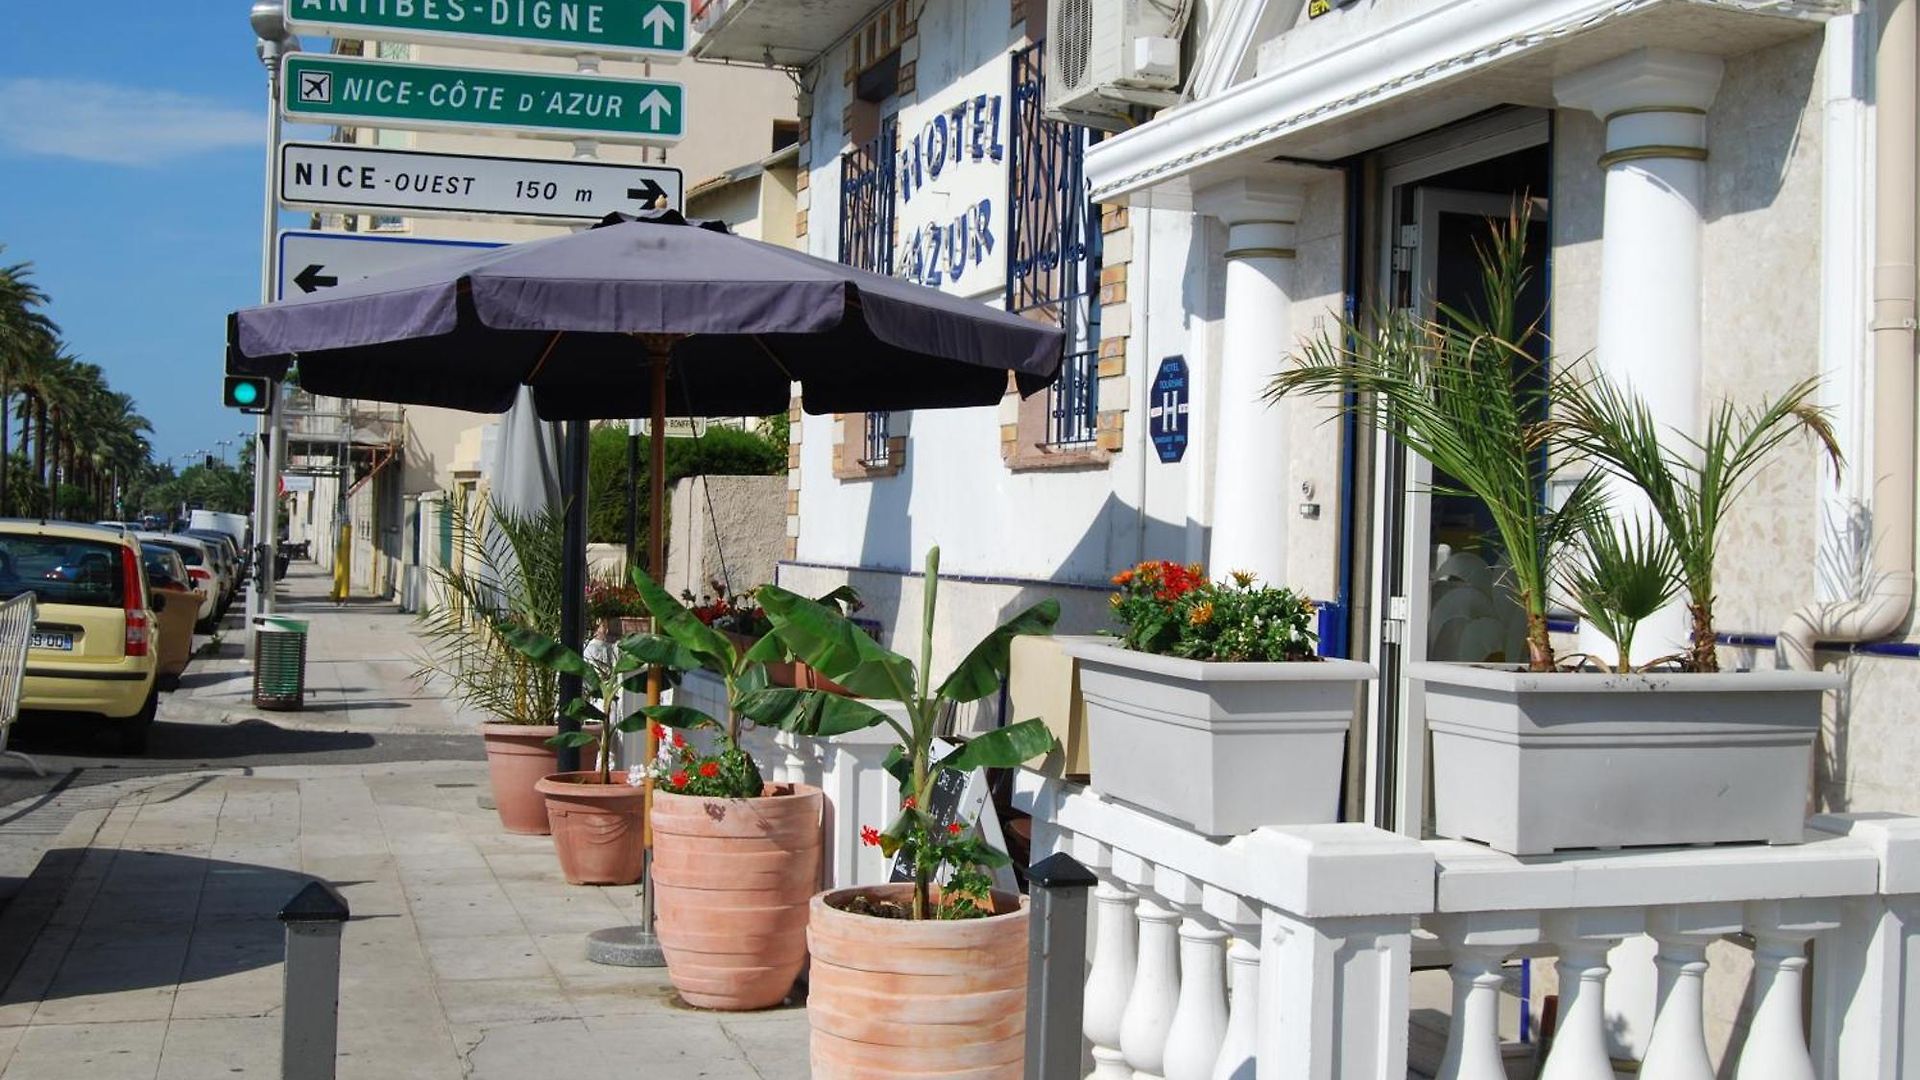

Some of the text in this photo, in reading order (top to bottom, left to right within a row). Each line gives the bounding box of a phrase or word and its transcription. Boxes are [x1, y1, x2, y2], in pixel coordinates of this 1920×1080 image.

[343, 78, 505, 110] NICE-CÔTE
[899, 94, 1004, 203] HOTEL
[515, 180, 558, 200] 150
[575, 188, 592, 202] m
[900, 198, 995, 286] AZUR
[1162, 390, 1179, 432] H
